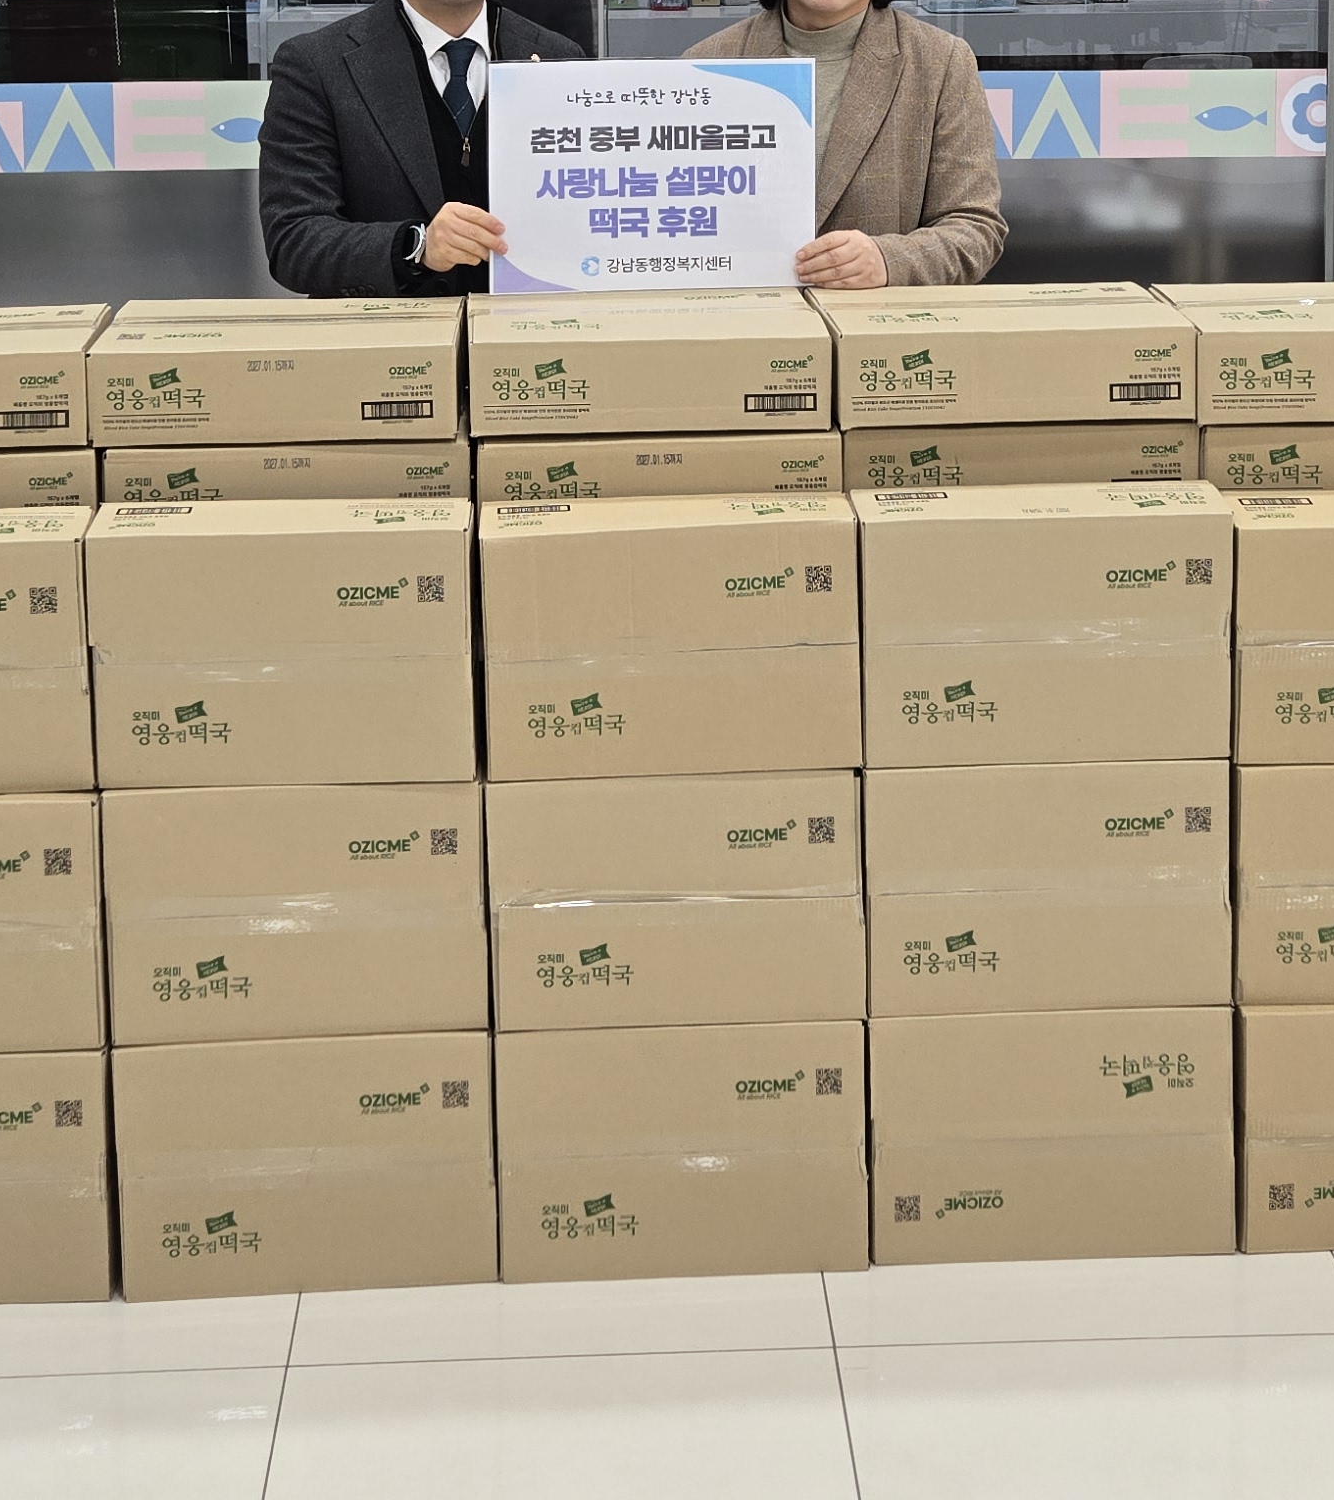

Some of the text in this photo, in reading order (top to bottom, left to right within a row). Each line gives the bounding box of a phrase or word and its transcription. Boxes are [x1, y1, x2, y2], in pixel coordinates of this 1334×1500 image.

[621, 86, 665, 106] 따뜻한
[671, 88, 712, 106] 강남동
[530, 123, 777, 153] 춘천 중부 새마을금고
[536, 165, 756, 199] 사랑나눔 설맞이
[589, 206, 718, 238] 떡국 후원
[606, 257, 732, 274] 강남동행정복지센터
[1135, 349, 1171, 357] OZICME
[389, 366, 427, 375] OZICME
[771, 360, 807, 368] OZICME
[861, 359, 886, 368] 오직미
[20, 376, 58, 384] OZICME
[505, 471, 531, 480] 오직미
[1106, 569, 1167, 582] OZICME
[725, 576, 785, 591] OZICME
[337, 586, 399, 600] OZICME
[1277, 692, 1302, 701] 오직미
[529, 704, 555, 714] 오직미
[1105, 817, 1165, 831] OZICME
[727, 828, 787, 842] OZICME
[349, 839, 410, 853] OZICME
[736, 1079, 795, 1093] OZICME
[359, 1092, 421, 1108] OZICME
[945, 1196, 1003, 1210] OZICME
